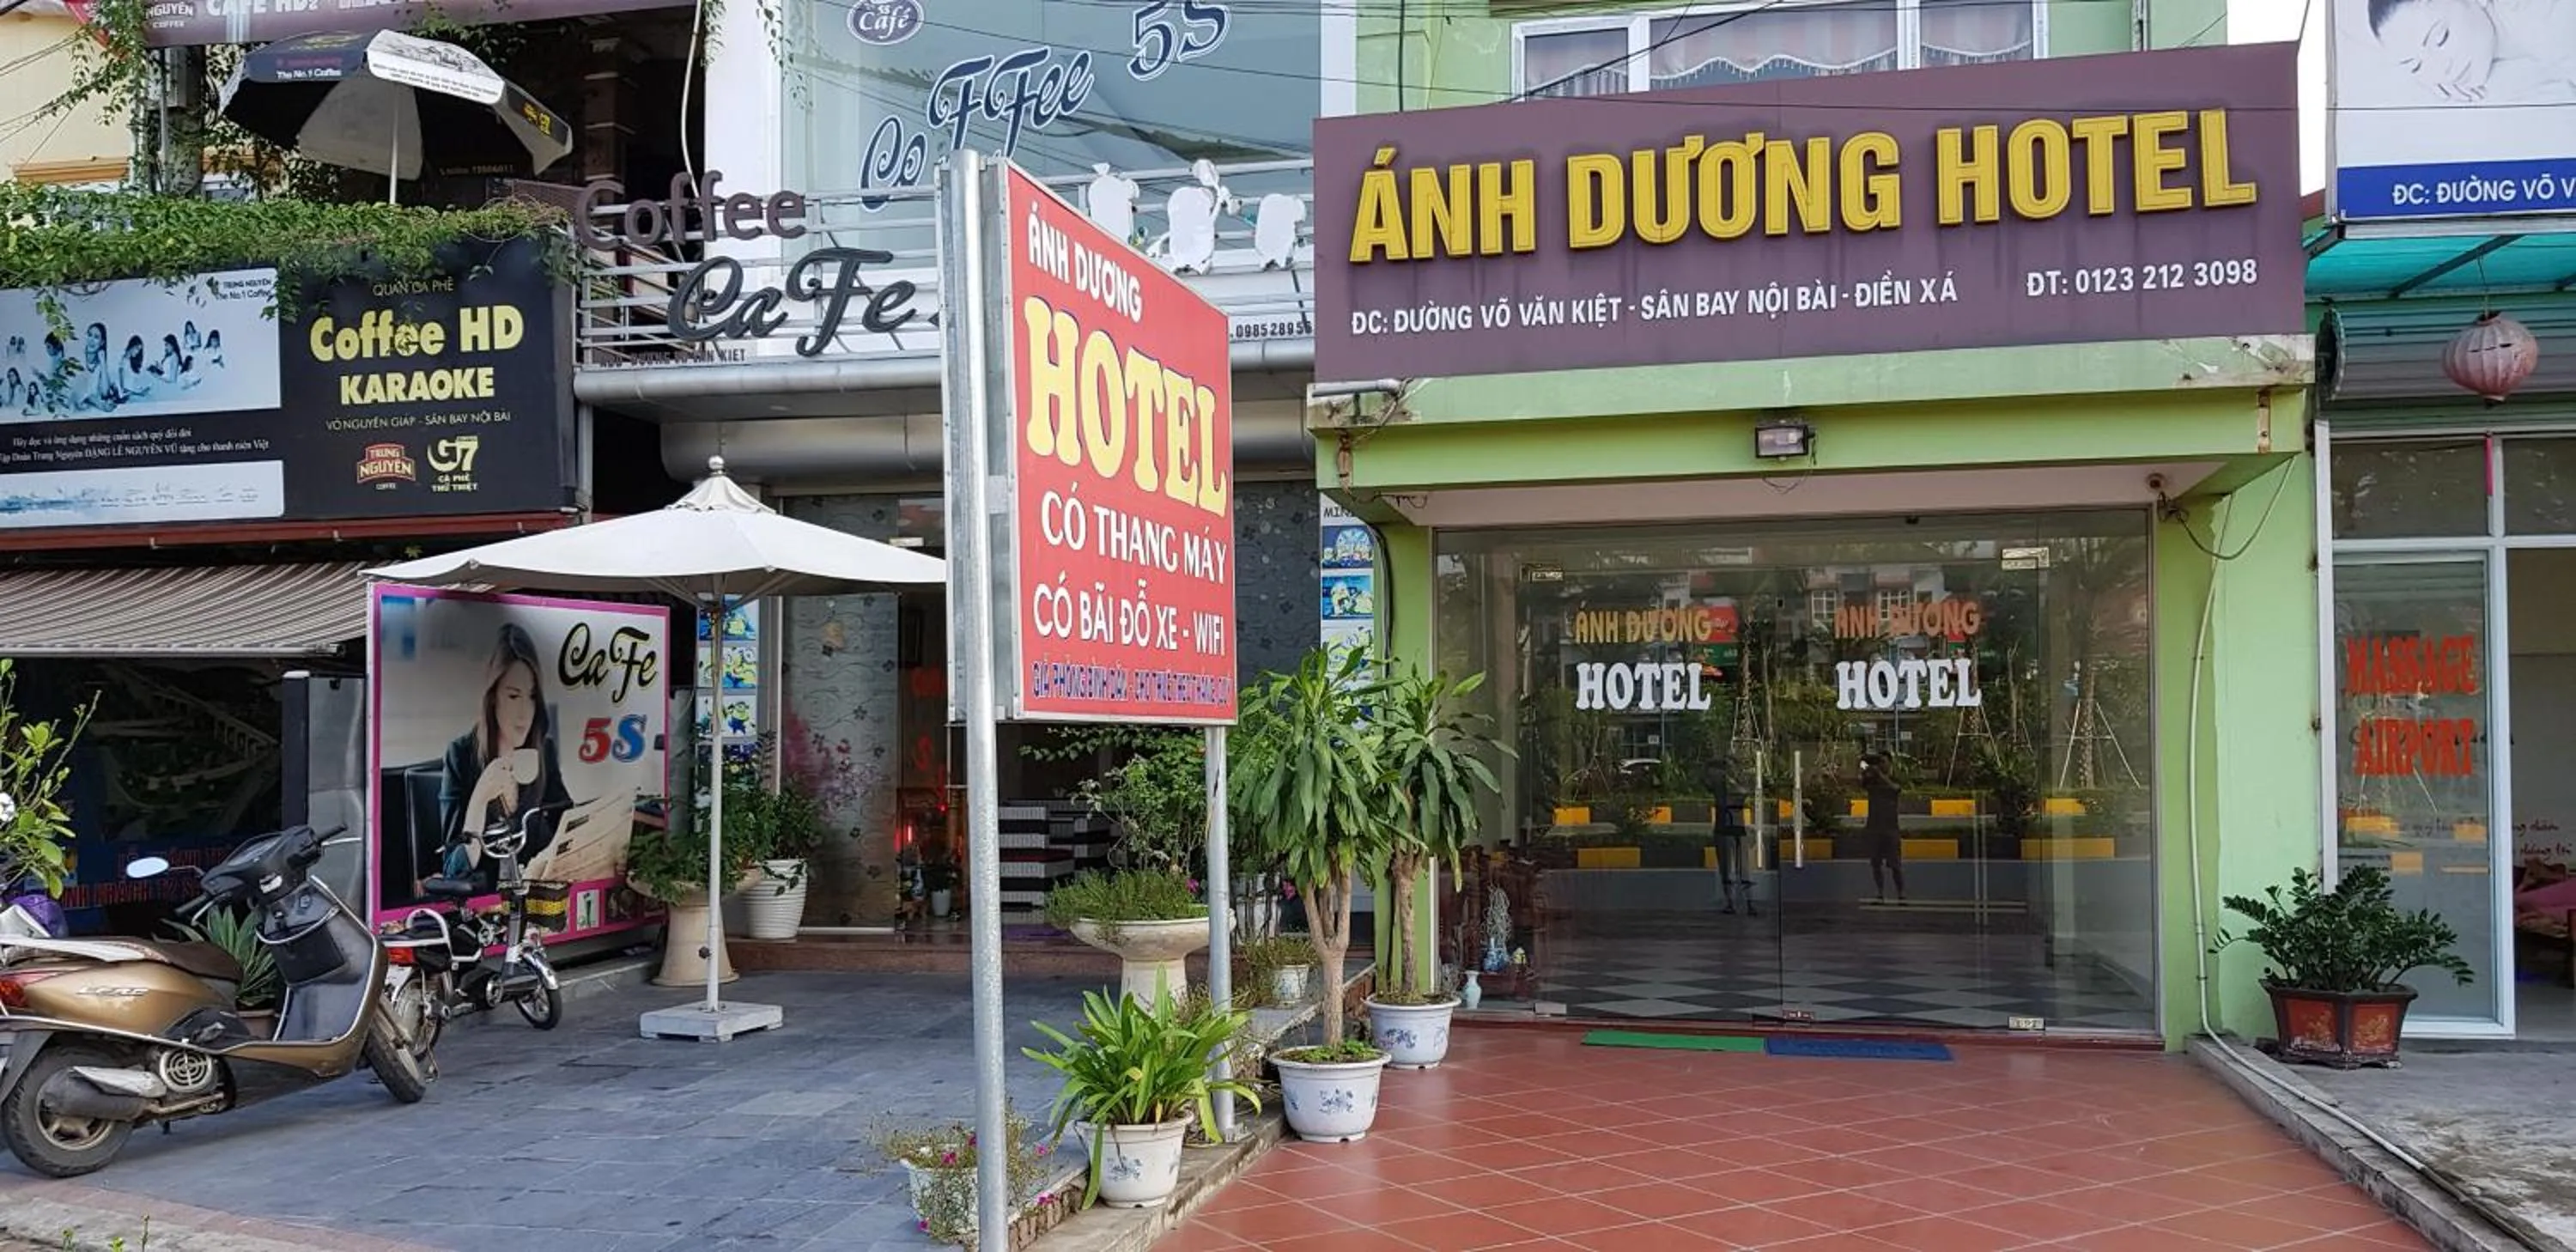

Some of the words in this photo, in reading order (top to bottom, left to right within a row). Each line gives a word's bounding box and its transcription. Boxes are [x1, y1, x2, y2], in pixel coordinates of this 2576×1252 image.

[860, 5, 911, 40] Café
[576, 171, 805, 251] Coffee
[1349, 147, 1535, 263] ÁNH
[1567, 131, 1902, 249] DƯƠNG
[1935, 108, 2257, 227] HOTEL
[2392, 183, 2430, 205] ĐC:
[2436, 174, 2517, 204] ĐƯỜNG
[2522, 173, 2555, 200] VÕ
[1028, 201, 1071, 284] ÁNH
[1074, 241, 1143, 323] DƯƠNG
[2026, 270, 2068, 296] ĐT:
[2075, 267, 2135, 294] 0123
[2142, 264, 2184, 289] 212
[2194, 258, 2257, 287] 3098
[1352, 310, 1388, 334] ĐC:
[1394, 301, 1473, 332] ĐƯỜNG
[1479, 297, 1510, 328] VÕ
[1518, 295, 1564, 326] VĂN
[1571, 293, 1622, 328] KIỆT
[1641, 289, 1689, 320] SÂN
[1696, 290, 1740, 317] BAY
[1747, 281, 1789, 319] NỘI
[1796, 279, 1837, 311] BÀI
[1854, 270, 1911, 307] ĐIỀN
[1920, 270, 1958, 303] XÁ
[310, 309, 446, 362] Coffee
[459, 305, 524, 352] HD
[340, 367, 495, 405] KARAOKE
[1024, 295, 1227, 517] HOTEL
[359, 459, 412, 477] NGUYÊN
[370, 447, 399, 458] TRUNG
[1041, 481, 1086, 550] CÓ
[1092, 504, 1178, 573] THANG
[1183, 526, 1226, 584] MÁY
[1033, 570, 1072, 638] CÓ
[1079, 581, 1115, 643] BÃI
[1120, 578, 1151, 647] ĐỖ
[1155, 604, 1178, 650] XE
[1194, 610, 1226, 656] WIFI
[1576, 662, 1711, 710] HOTEL
[1835, 659, 1982, 709] HOTEL
[2346, 633, 2476, 694] MASSAGE
[578, 714, 647, 763] 5S
[2355, 718, 2474, 777] AIRPORT
